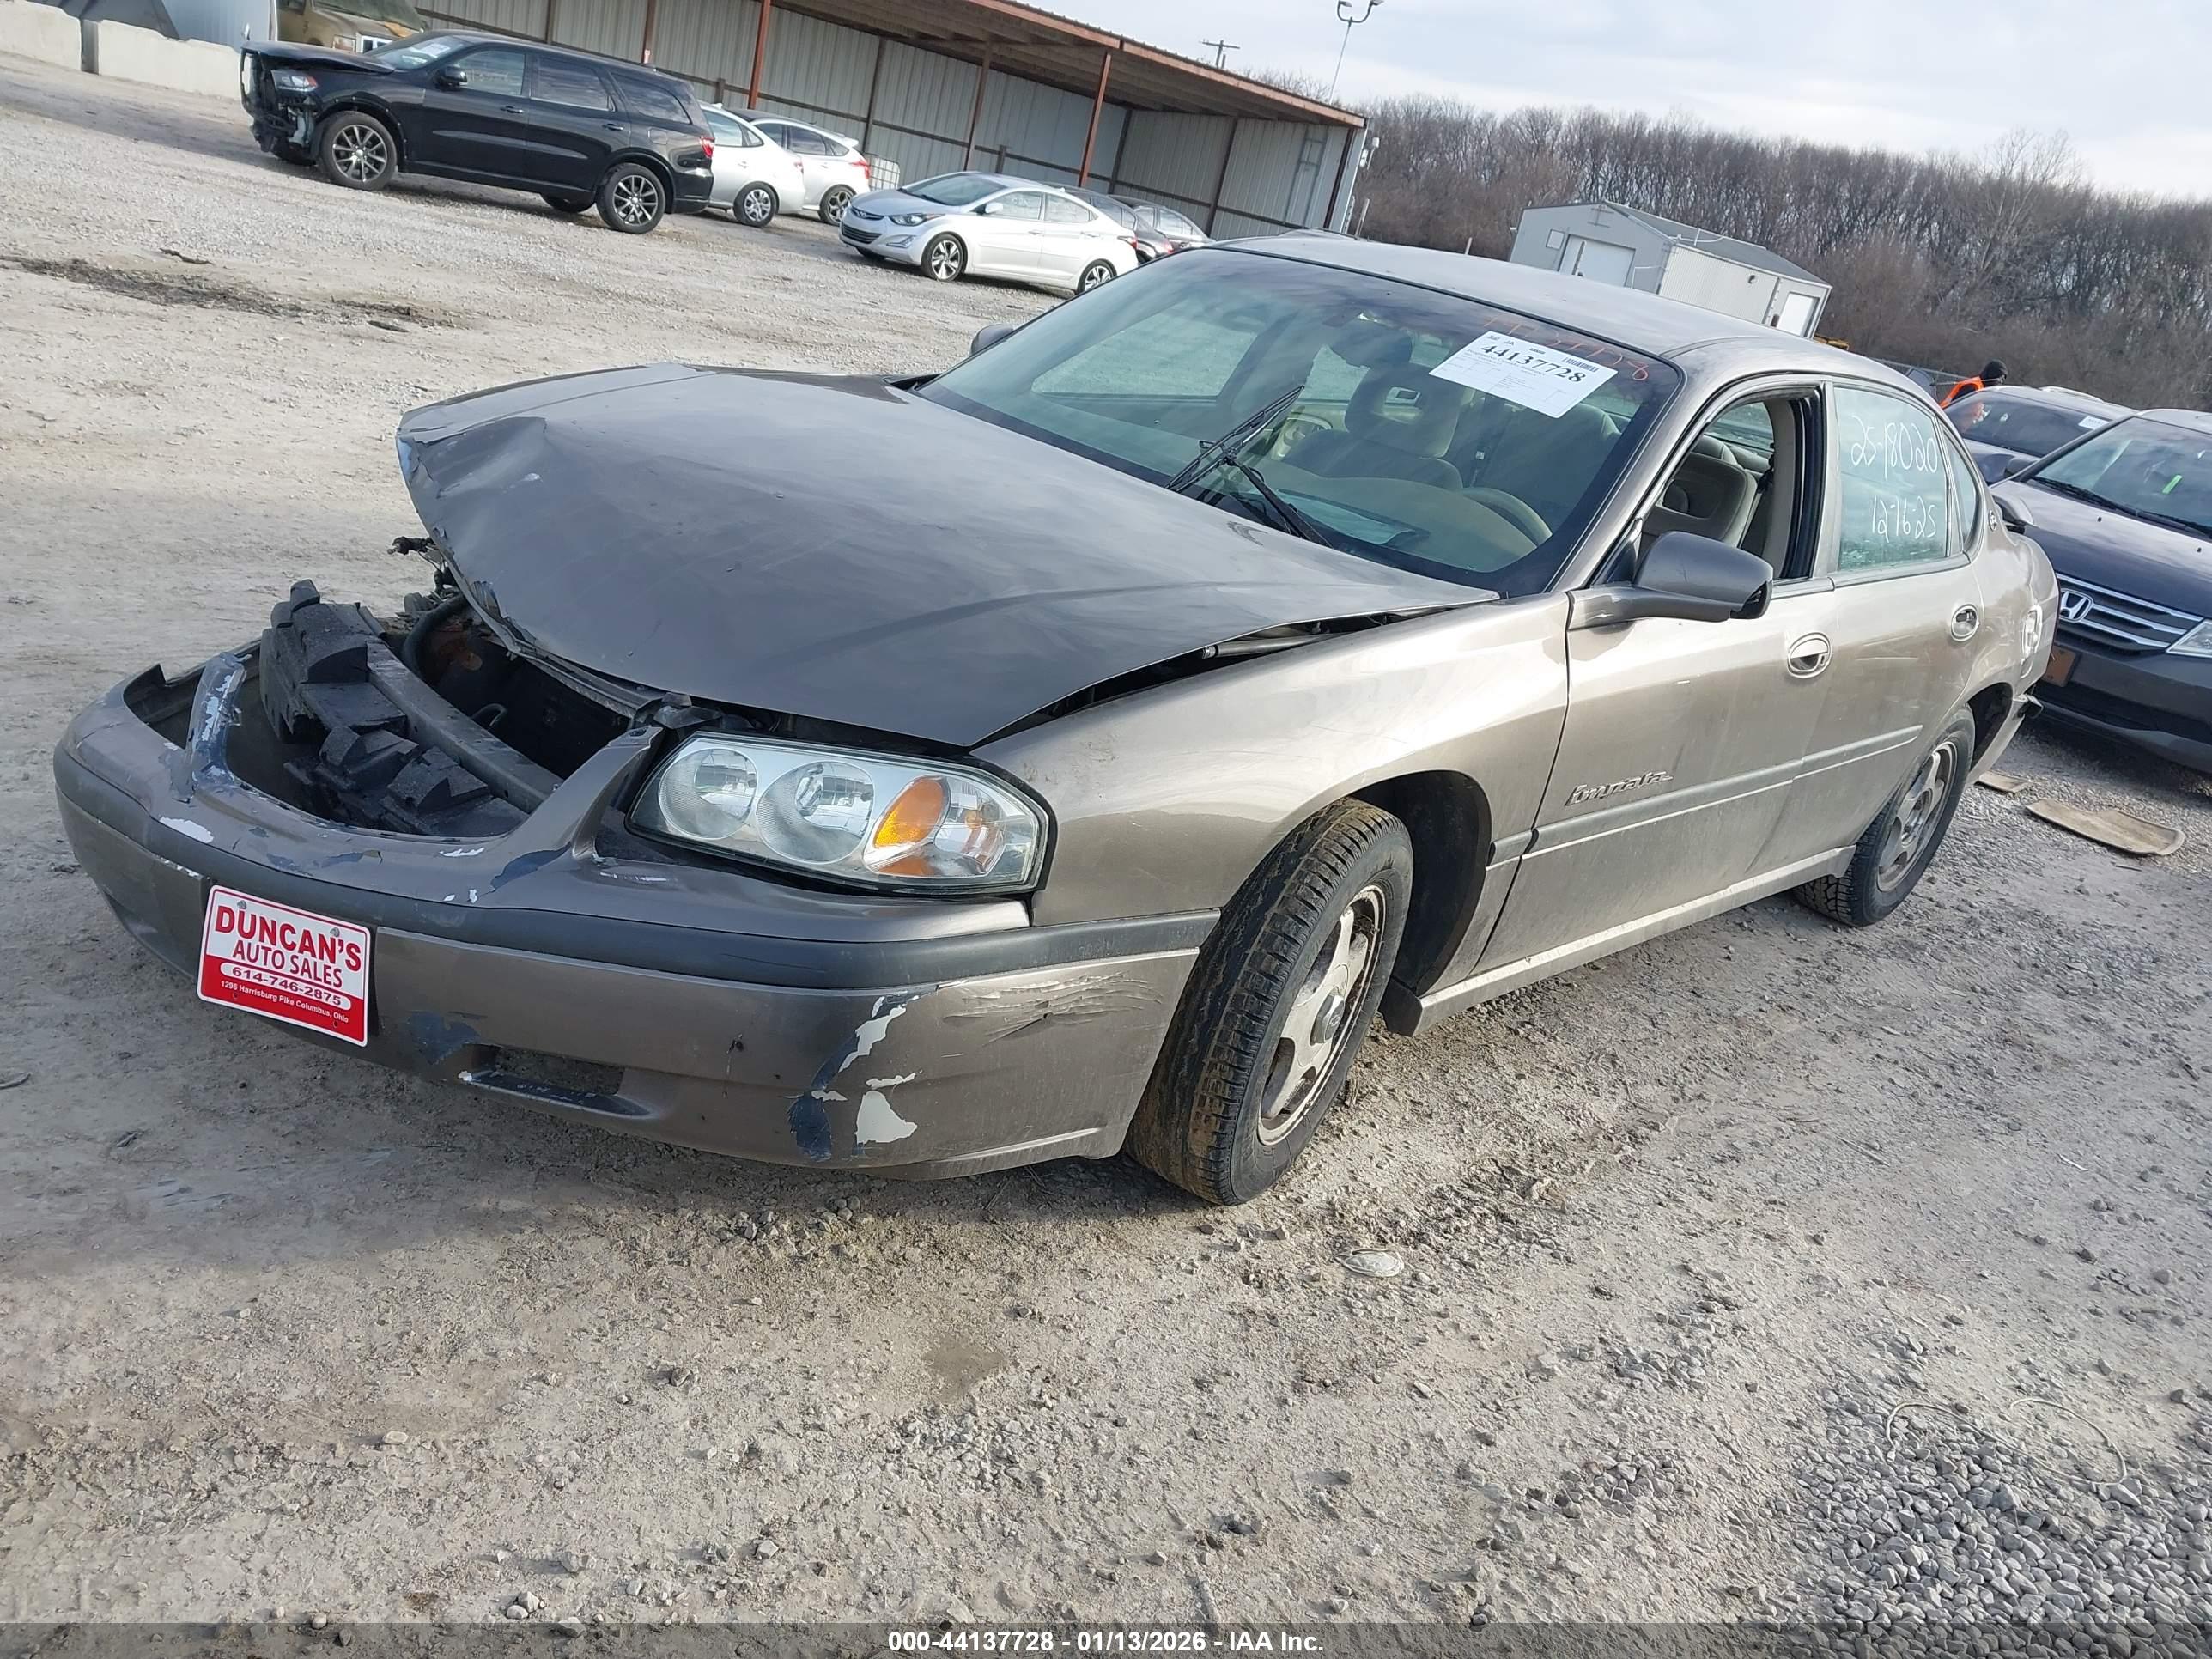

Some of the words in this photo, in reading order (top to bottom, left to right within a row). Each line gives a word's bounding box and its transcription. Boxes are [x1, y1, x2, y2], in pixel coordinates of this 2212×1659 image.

[1480, 345, 1587, 383] 44137728
[1564, 771, 1674, 806] Impala
[215, 904, 362, 972] DUNCAN'S
[233, 939, 285, 970] AUTO
[289, 955, 343, 988] SALES
[232, 967, 342, 1006] 614-746-2875
[239, 985, 277, 1002] Harrisburg
[278, 996, 295, 1006] Pike
[295, 1001, 332, 1018] Columbus,
[333, 1012, 349, 1023] Ohio
